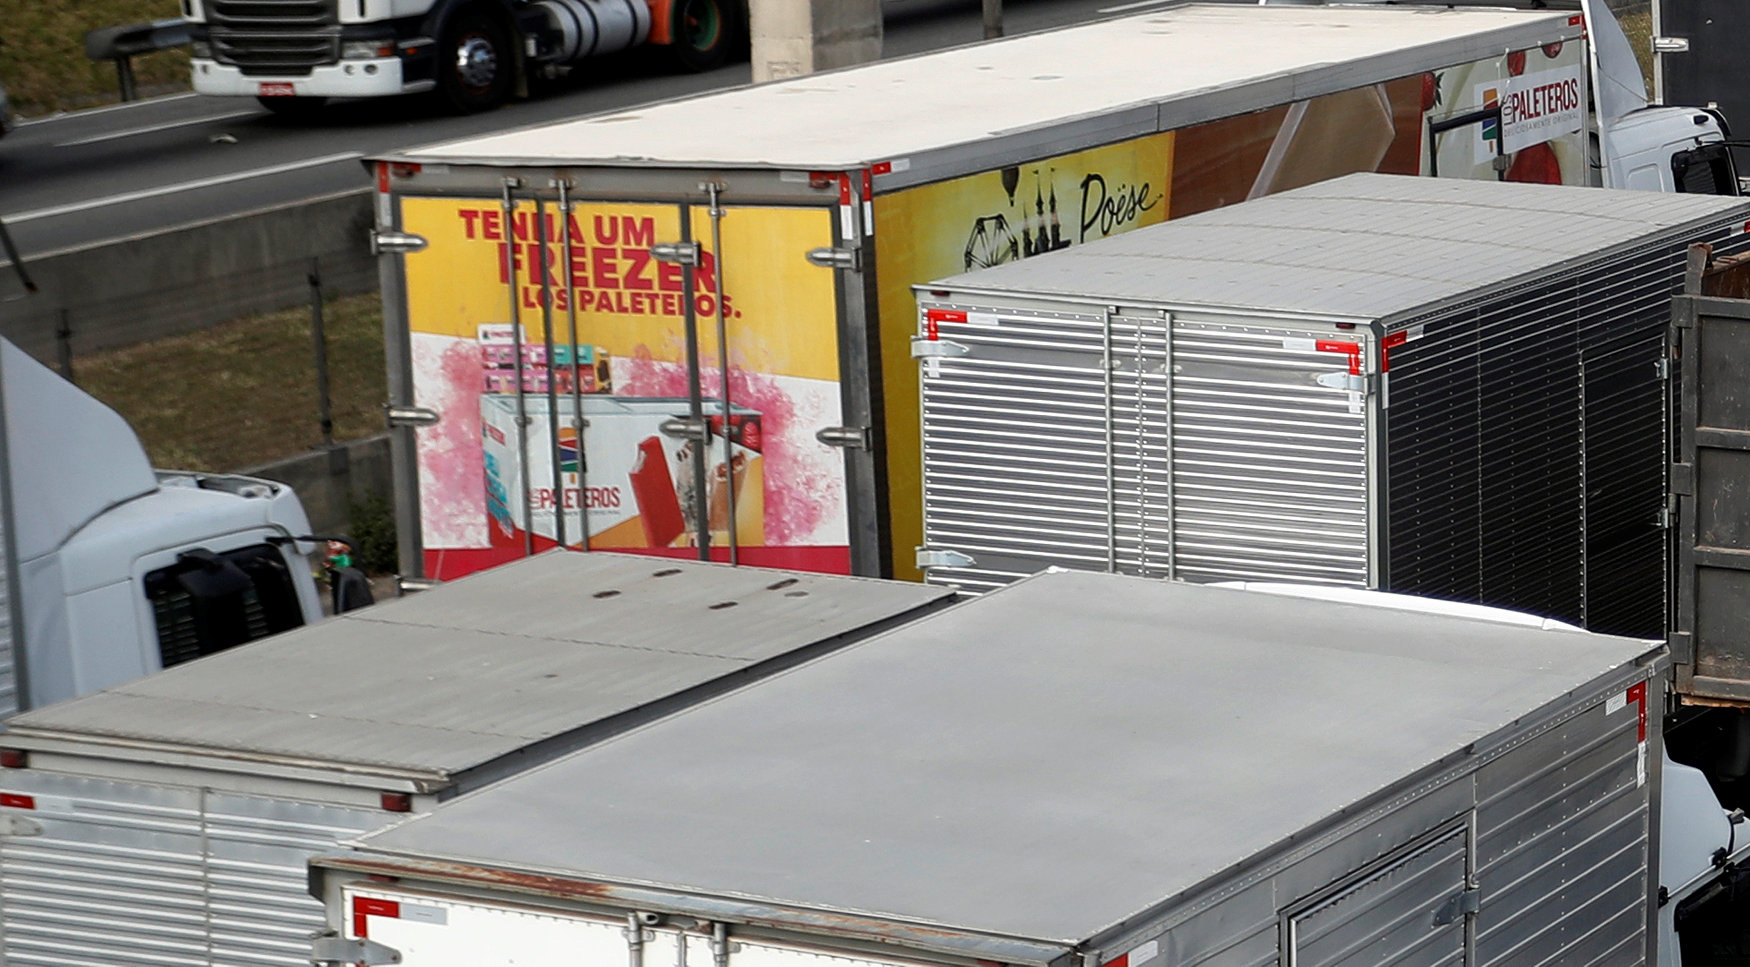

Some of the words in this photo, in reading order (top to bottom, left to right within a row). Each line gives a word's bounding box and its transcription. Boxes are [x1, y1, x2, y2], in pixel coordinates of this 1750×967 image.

[1512, 78, 1578, 124] PALETEROS
[593, 215, 655, 248] UM
[498, 242, 717, 293] FREEZER
[541, 487, 621, 509] PAETEROS
